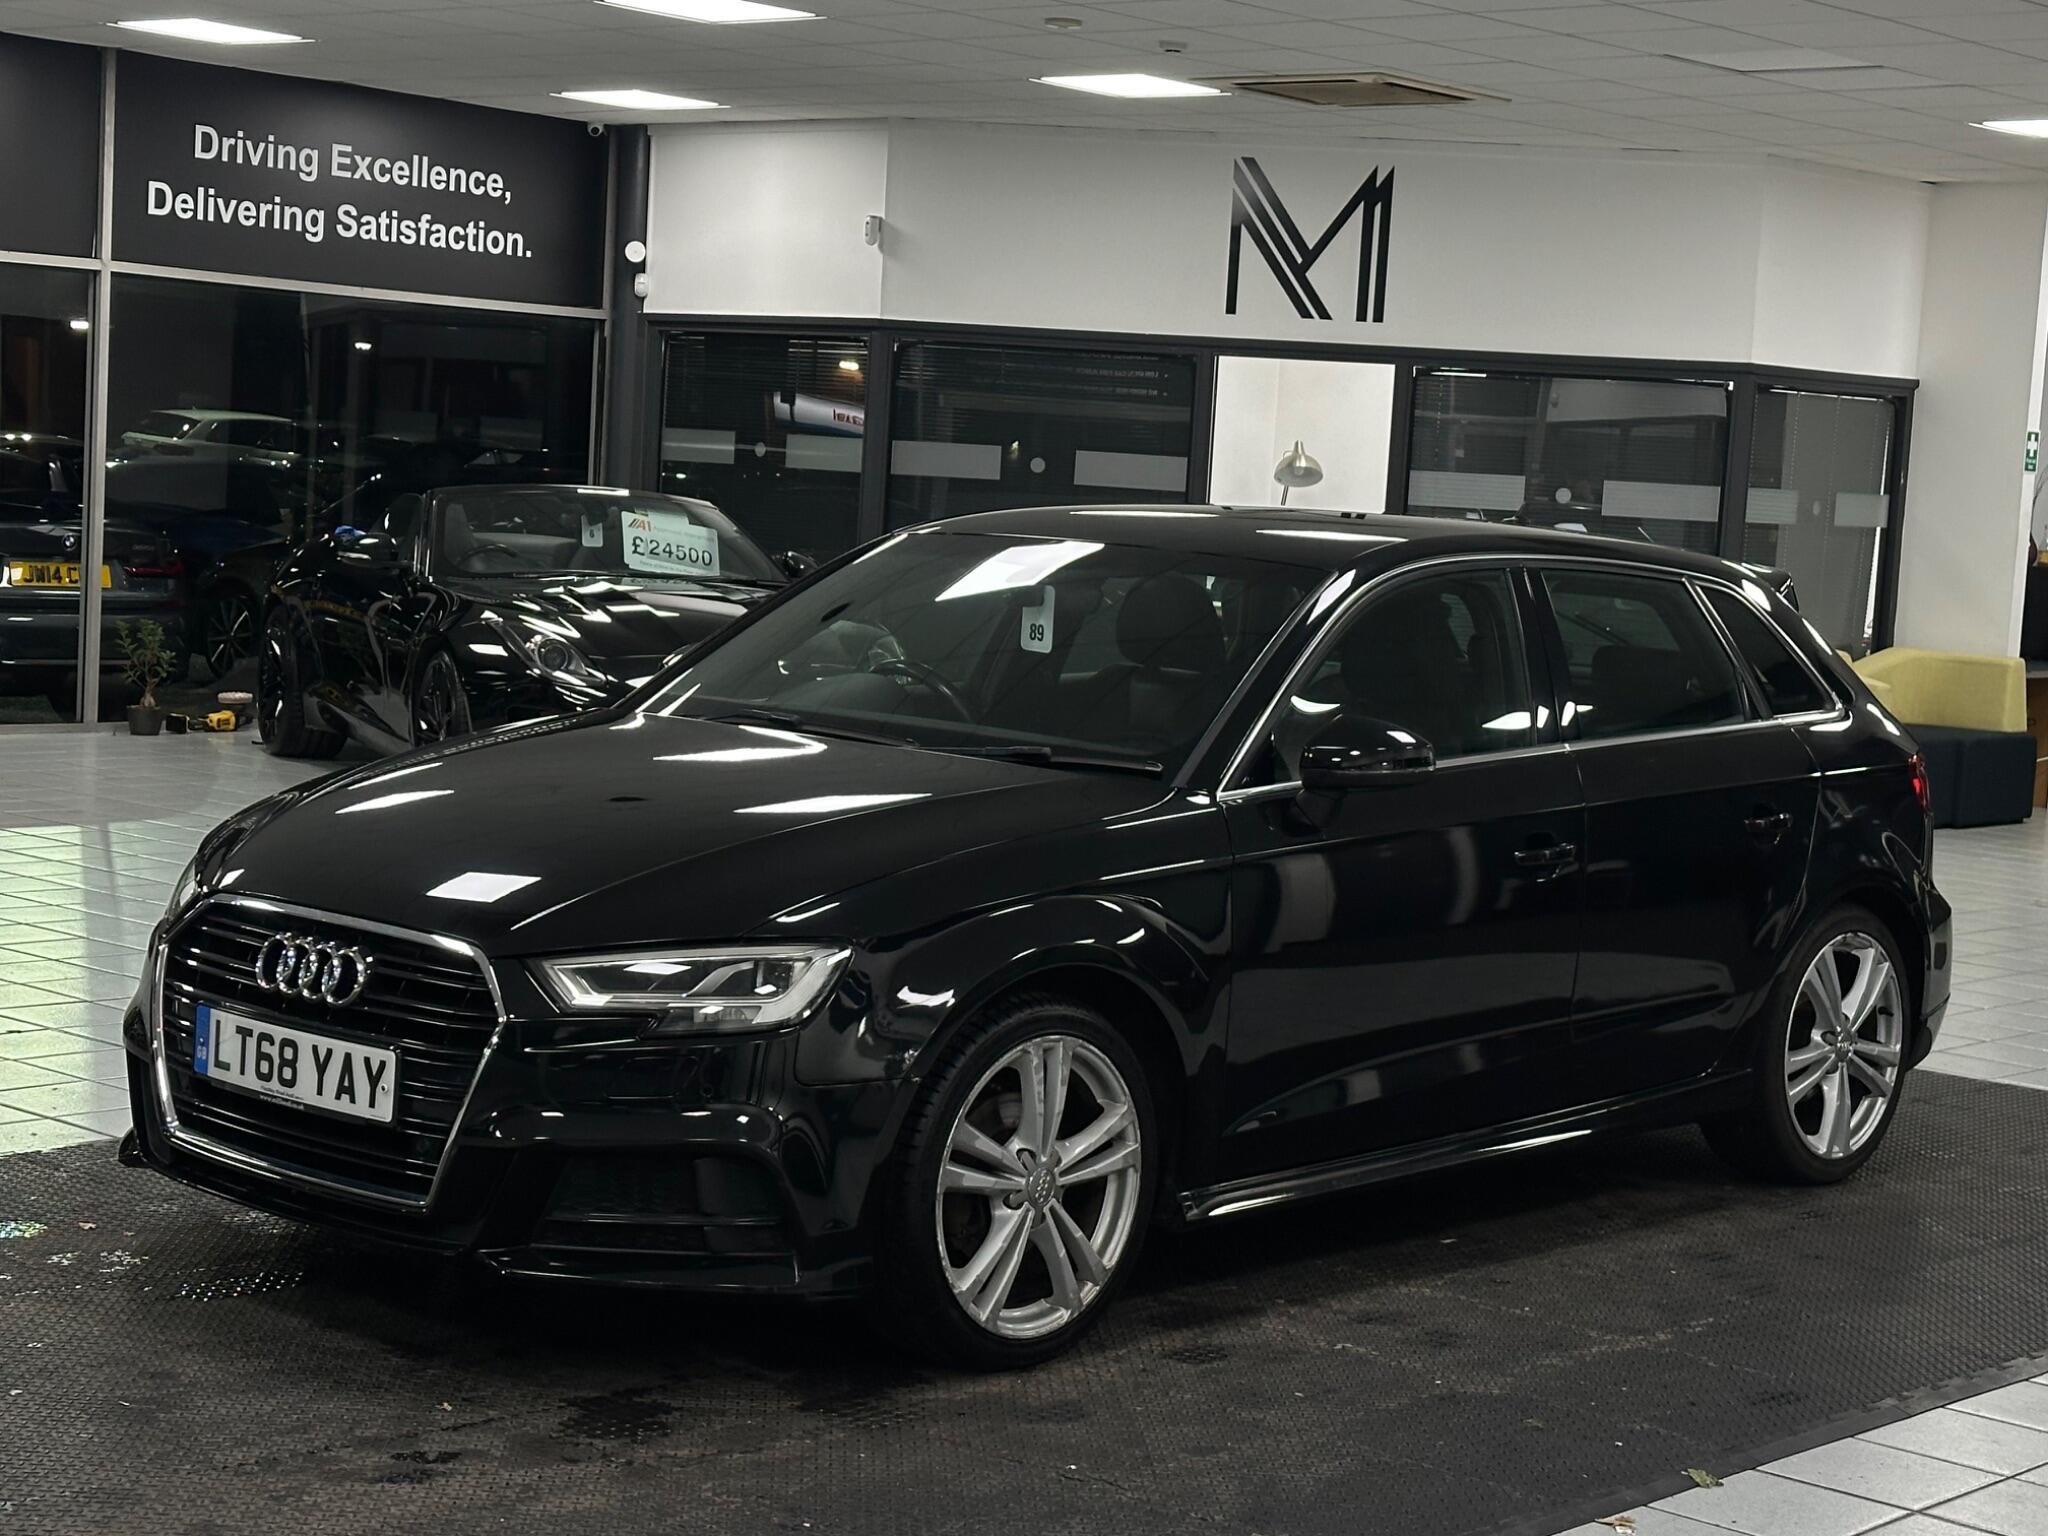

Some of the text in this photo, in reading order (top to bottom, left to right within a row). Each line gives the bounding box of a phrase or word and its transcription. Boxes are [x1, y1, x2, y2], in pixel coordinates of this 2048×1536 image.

[194, 124, 511, 205] Driving Excellence,
[147, 180, 532, 258] Delivering Satisfaction.
[631, 535, 713, 567] £24500
[1029, 623, 1045, 642] 89
[214, 1019, 387, 1109] LT68 YAY
